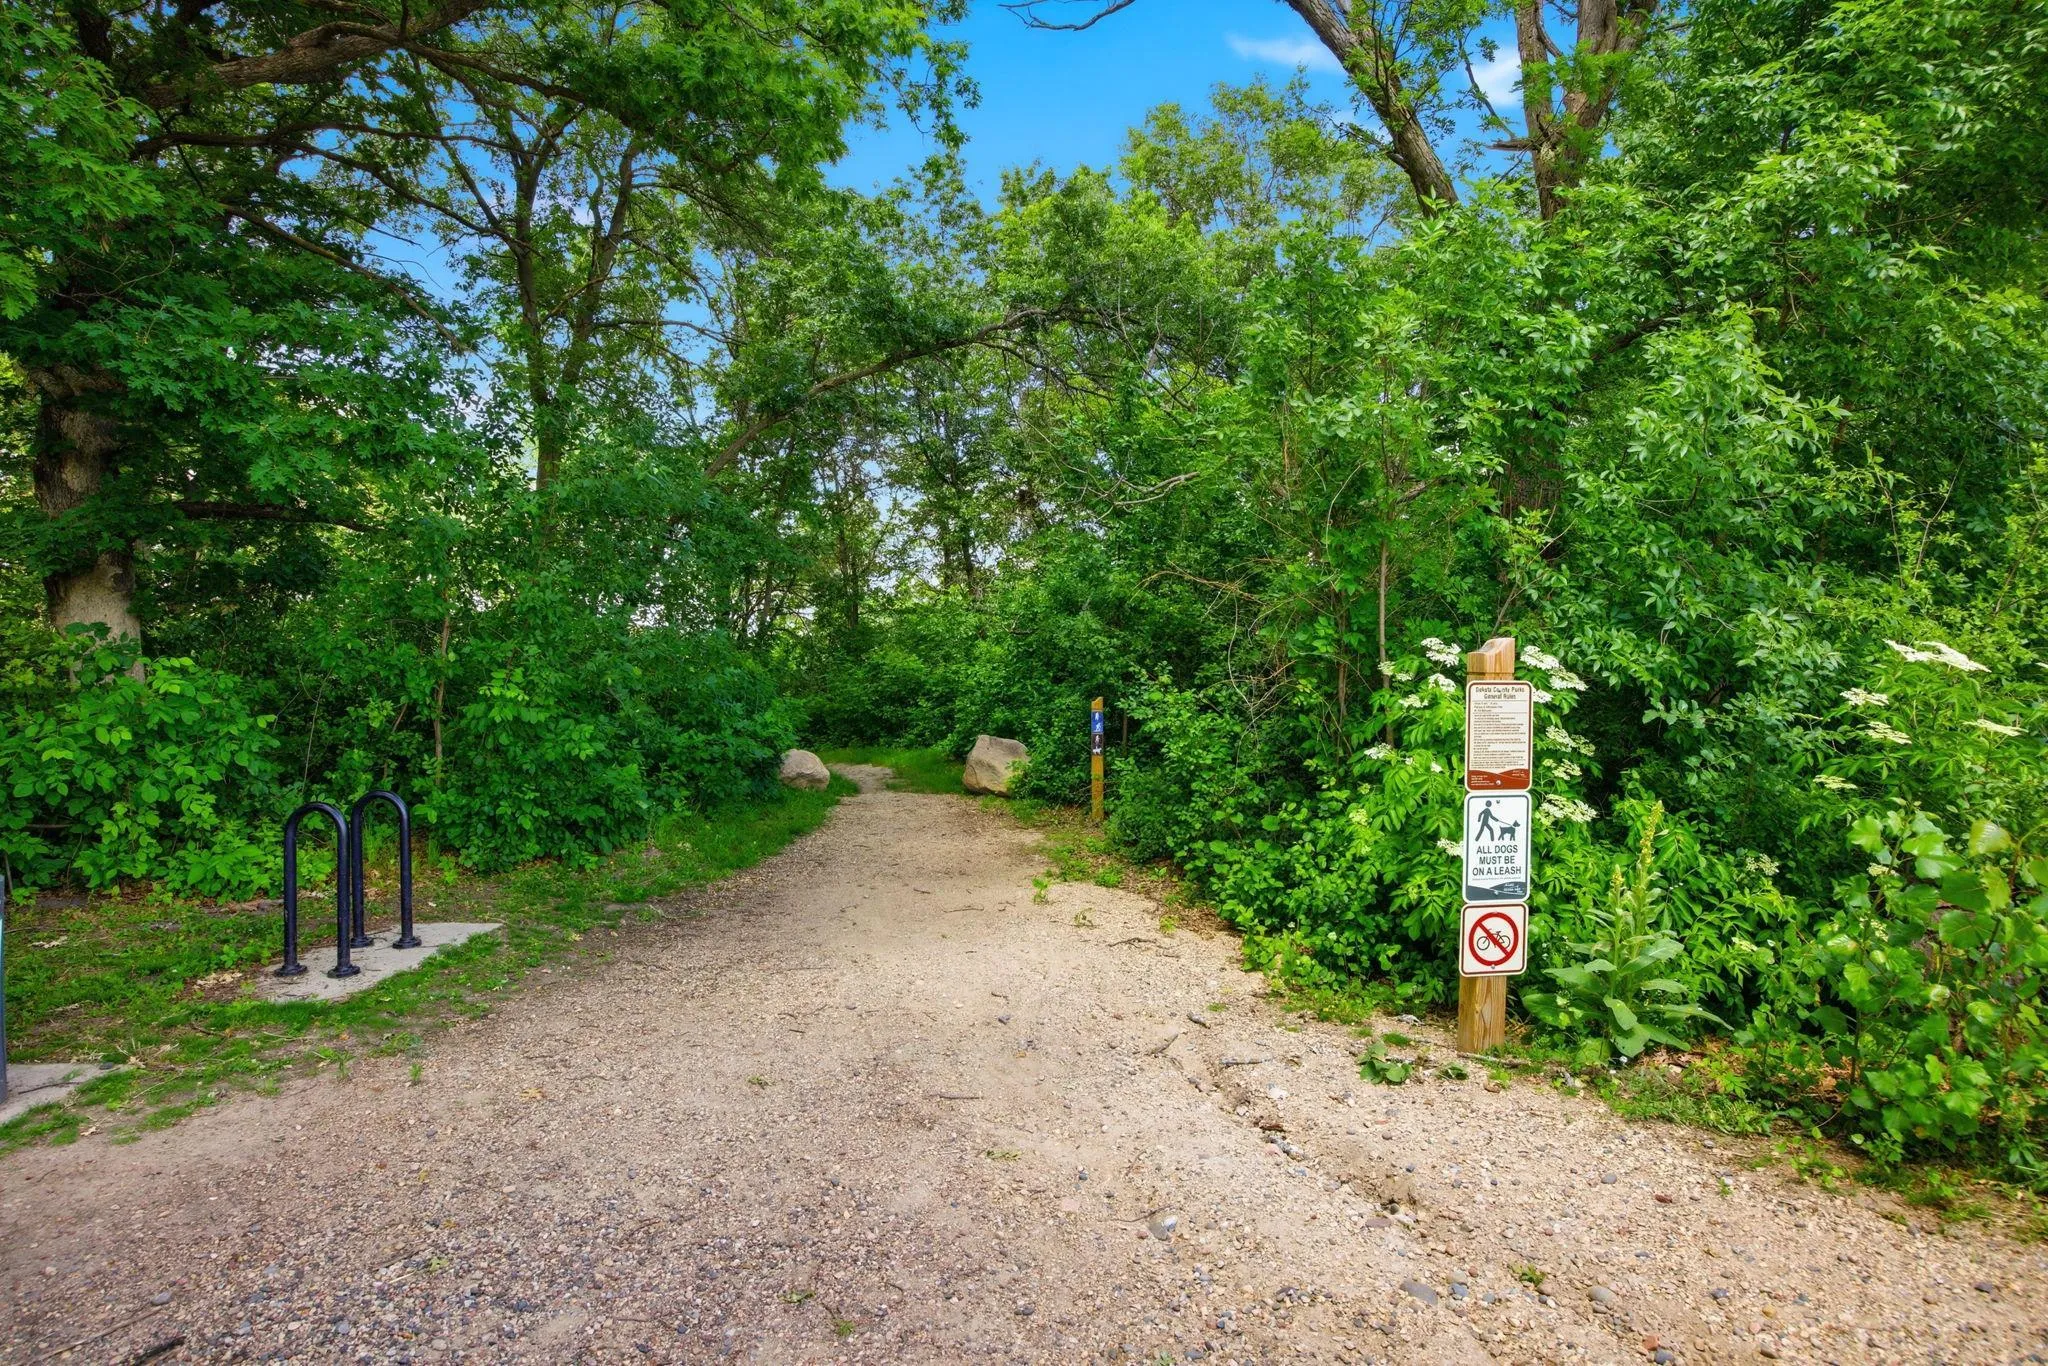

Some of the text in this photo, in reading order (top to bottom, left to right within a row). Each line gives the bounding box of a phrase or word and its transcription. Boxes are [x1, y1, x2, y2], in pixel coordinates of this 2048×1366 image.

[1476, 844, 1518, 854] ALL DOGS
[1479, 855, 1515, 865] MUST BE
[1472, 866, 1521, 876] ON A LEASH
